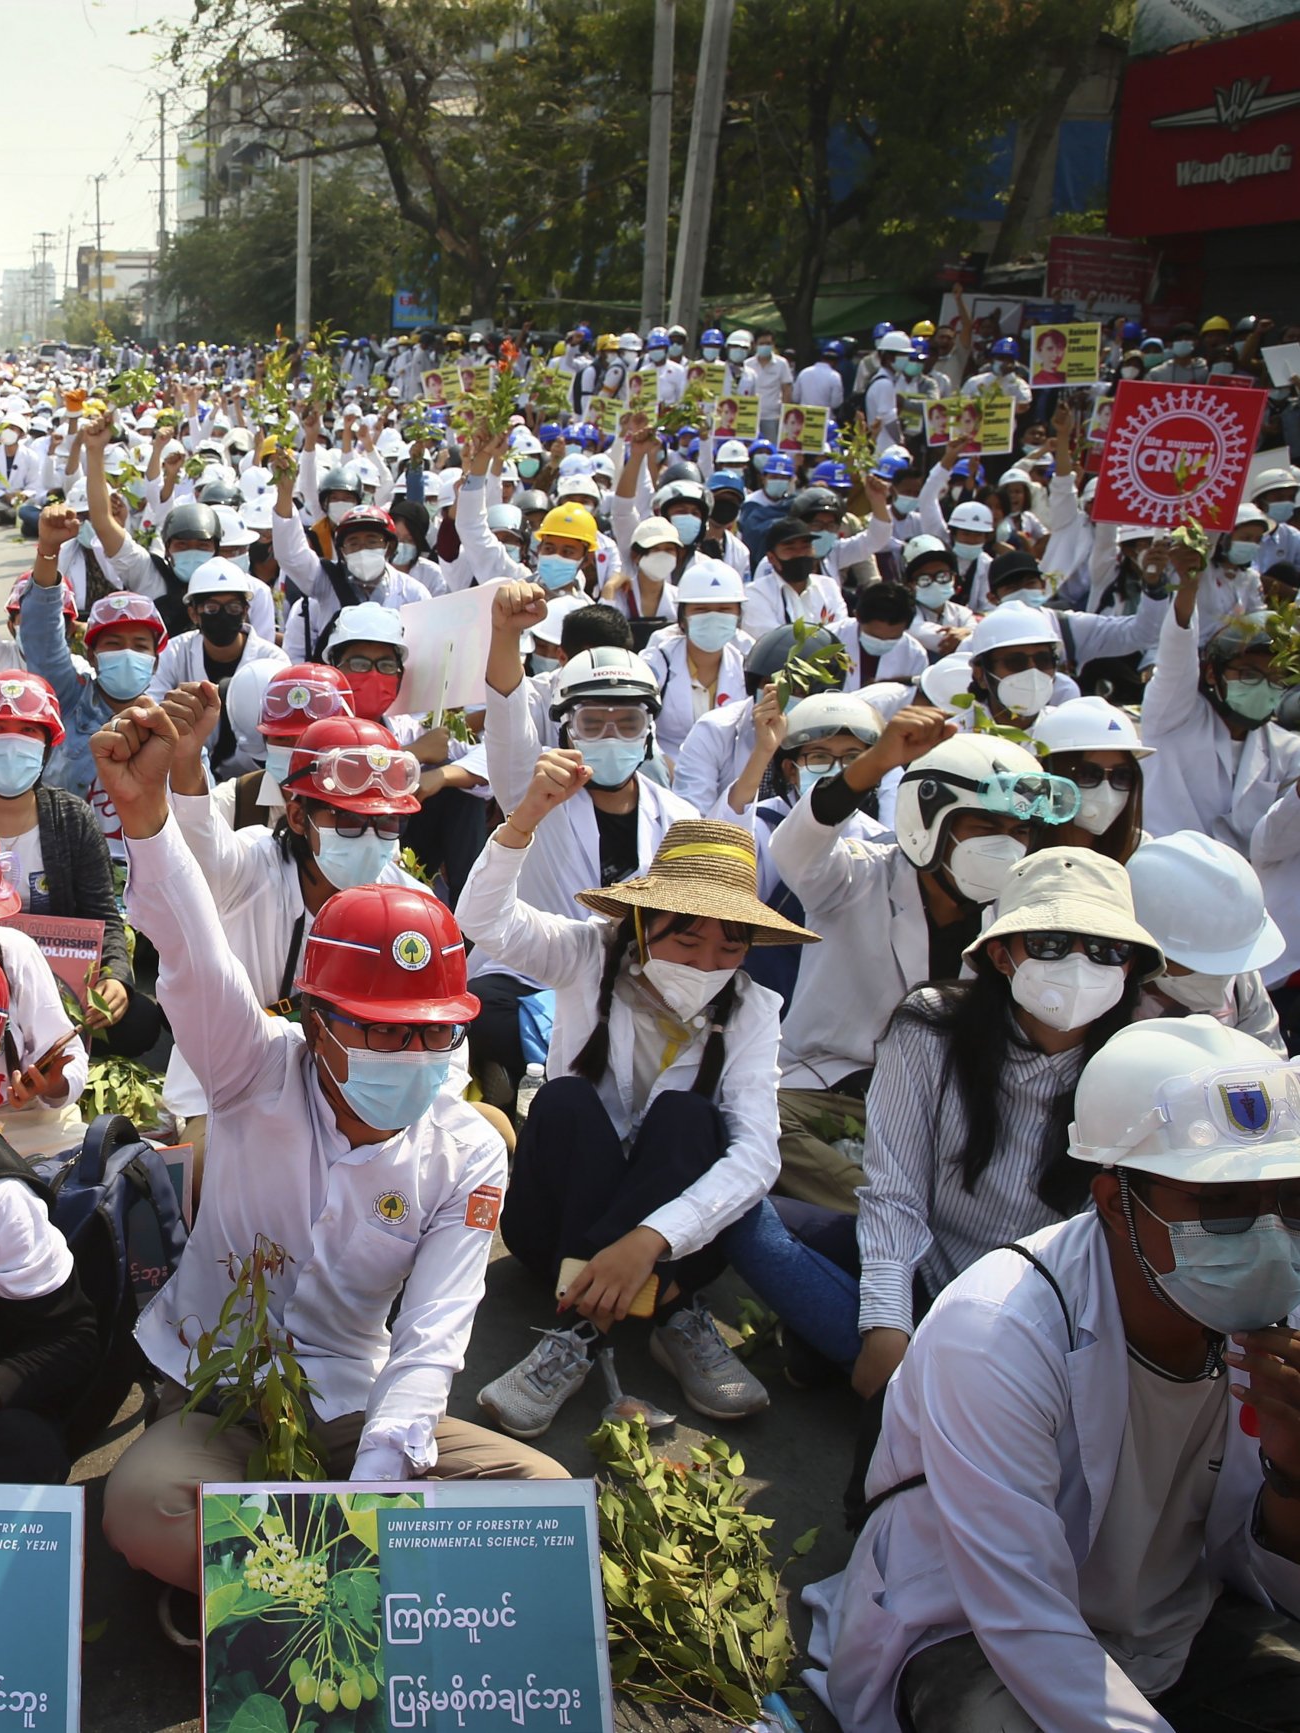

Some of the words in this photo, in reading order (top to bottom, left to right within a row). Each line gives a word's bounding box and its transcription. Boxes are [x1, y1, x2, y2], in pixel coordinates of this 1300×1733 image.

[1138, 449, 1215, 476] CRPH
[593, 670, 632, 678] HONDA
[20, 1524, 43, 1534] AND
[387, 1520, 453, 1531] UNIVERSITY
[457, 1520, 472, 1531] OF
[475, 1519, 533, 1531] FORESTRY
[536, 1519, 559, 1530] AND
[25, 1540, 58, 1551] YEZIN
[388, 1537, 482, 1548] ENVIRONMENTAL
[486, 1536, 538, 1548] SCIENCE,
[543, 1536, 575, 1546] YEZIN
[385, 1592, 517, 1644] ကြက်ဆူပင်
